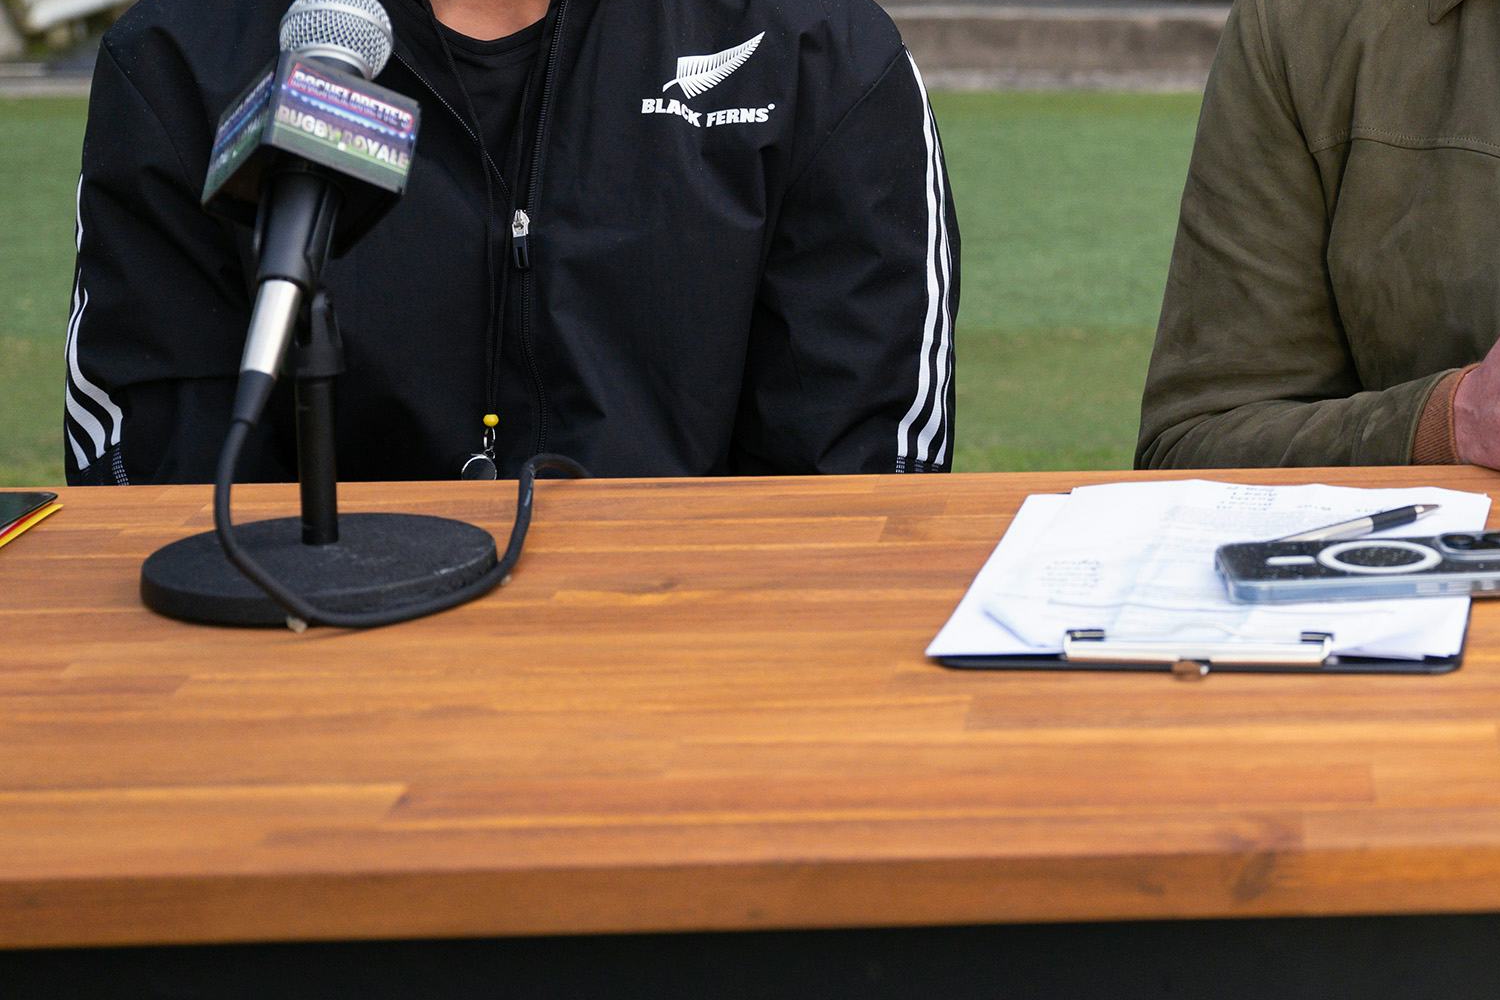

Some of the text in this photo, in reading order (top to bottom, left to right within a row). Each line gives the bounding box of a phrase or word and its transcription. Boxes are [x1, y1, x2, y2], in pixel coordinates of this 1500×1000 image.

[641, 99, 769, 127] BLACK FERNS
[276, 105, 411, 169] RUGBY ROYALE
